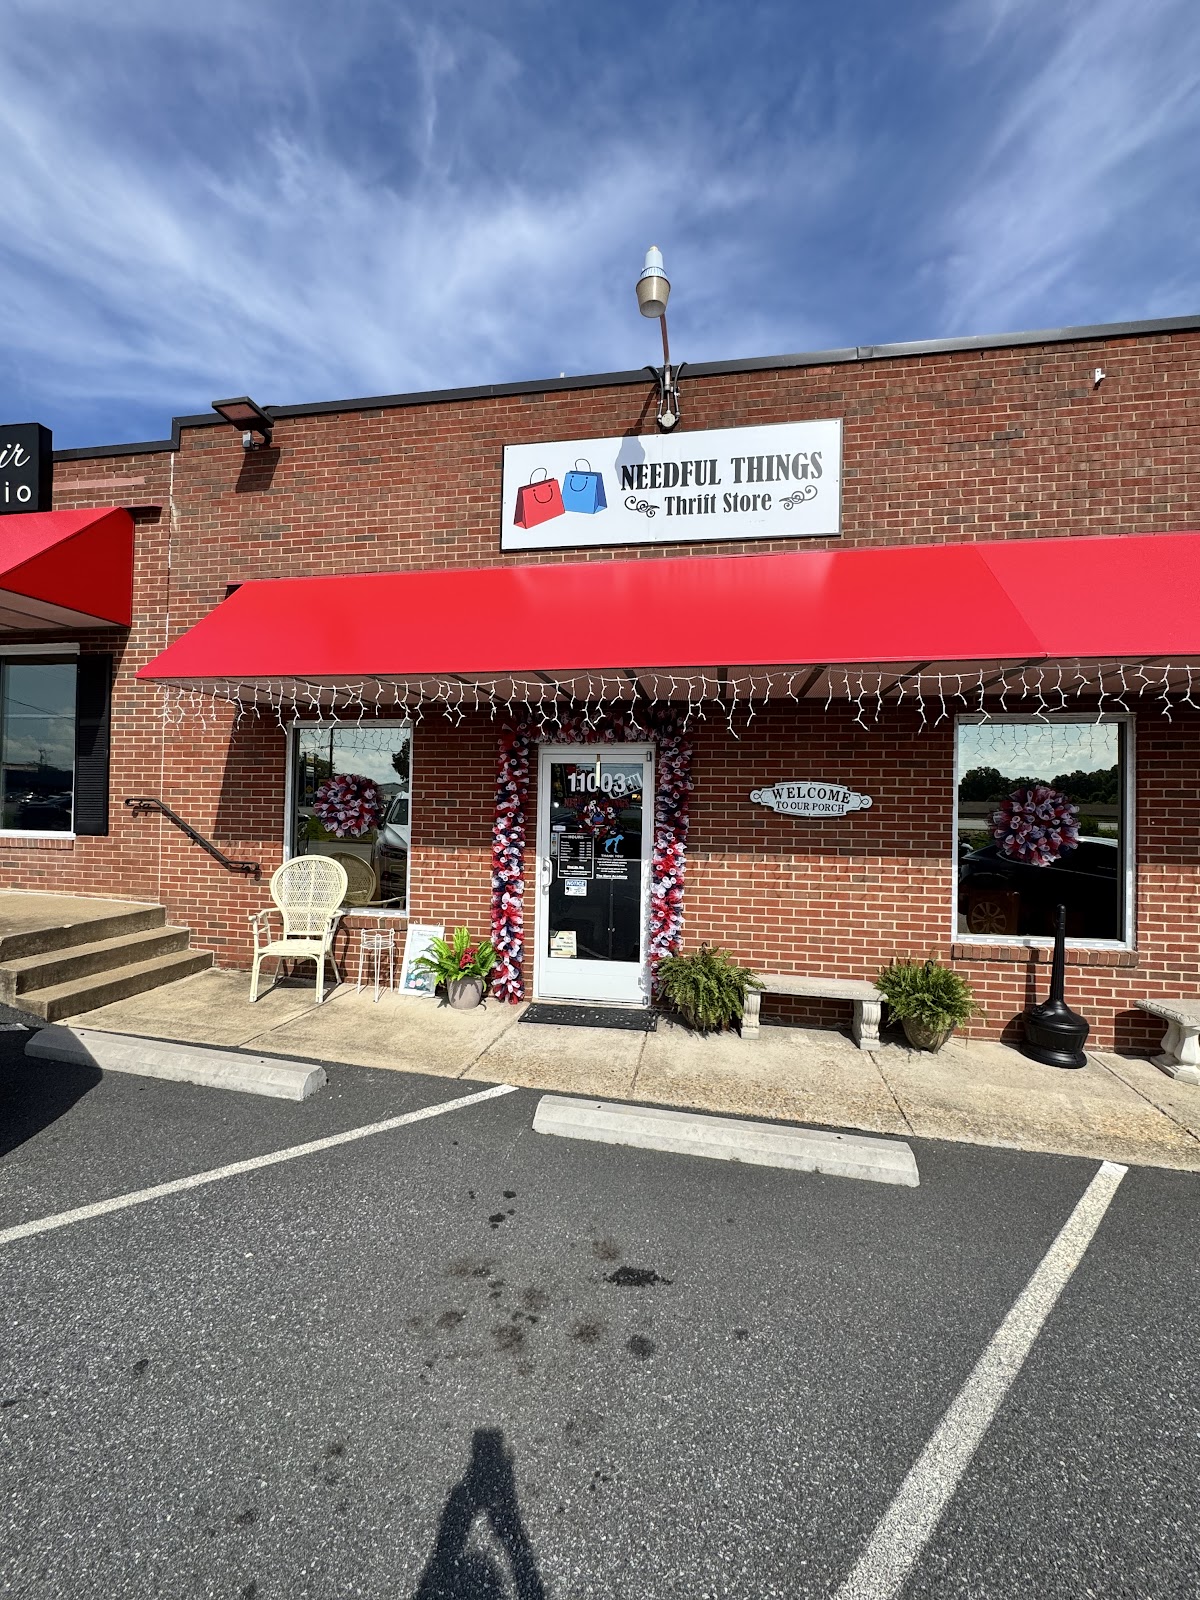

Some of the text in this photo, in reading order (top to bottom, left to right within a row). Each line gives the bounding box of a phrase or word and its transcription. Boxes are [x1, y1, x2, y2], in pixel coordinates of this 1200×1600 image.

[621, 451, 823, 491] NEEDFUL THINGS
[664, 492, 772, 516] Thrift Store
[567, 772, 626, 793] 11003
[771, 786, 852, 805] WELCOME
[776, 800, 845, 813] TO OUR PORCH
